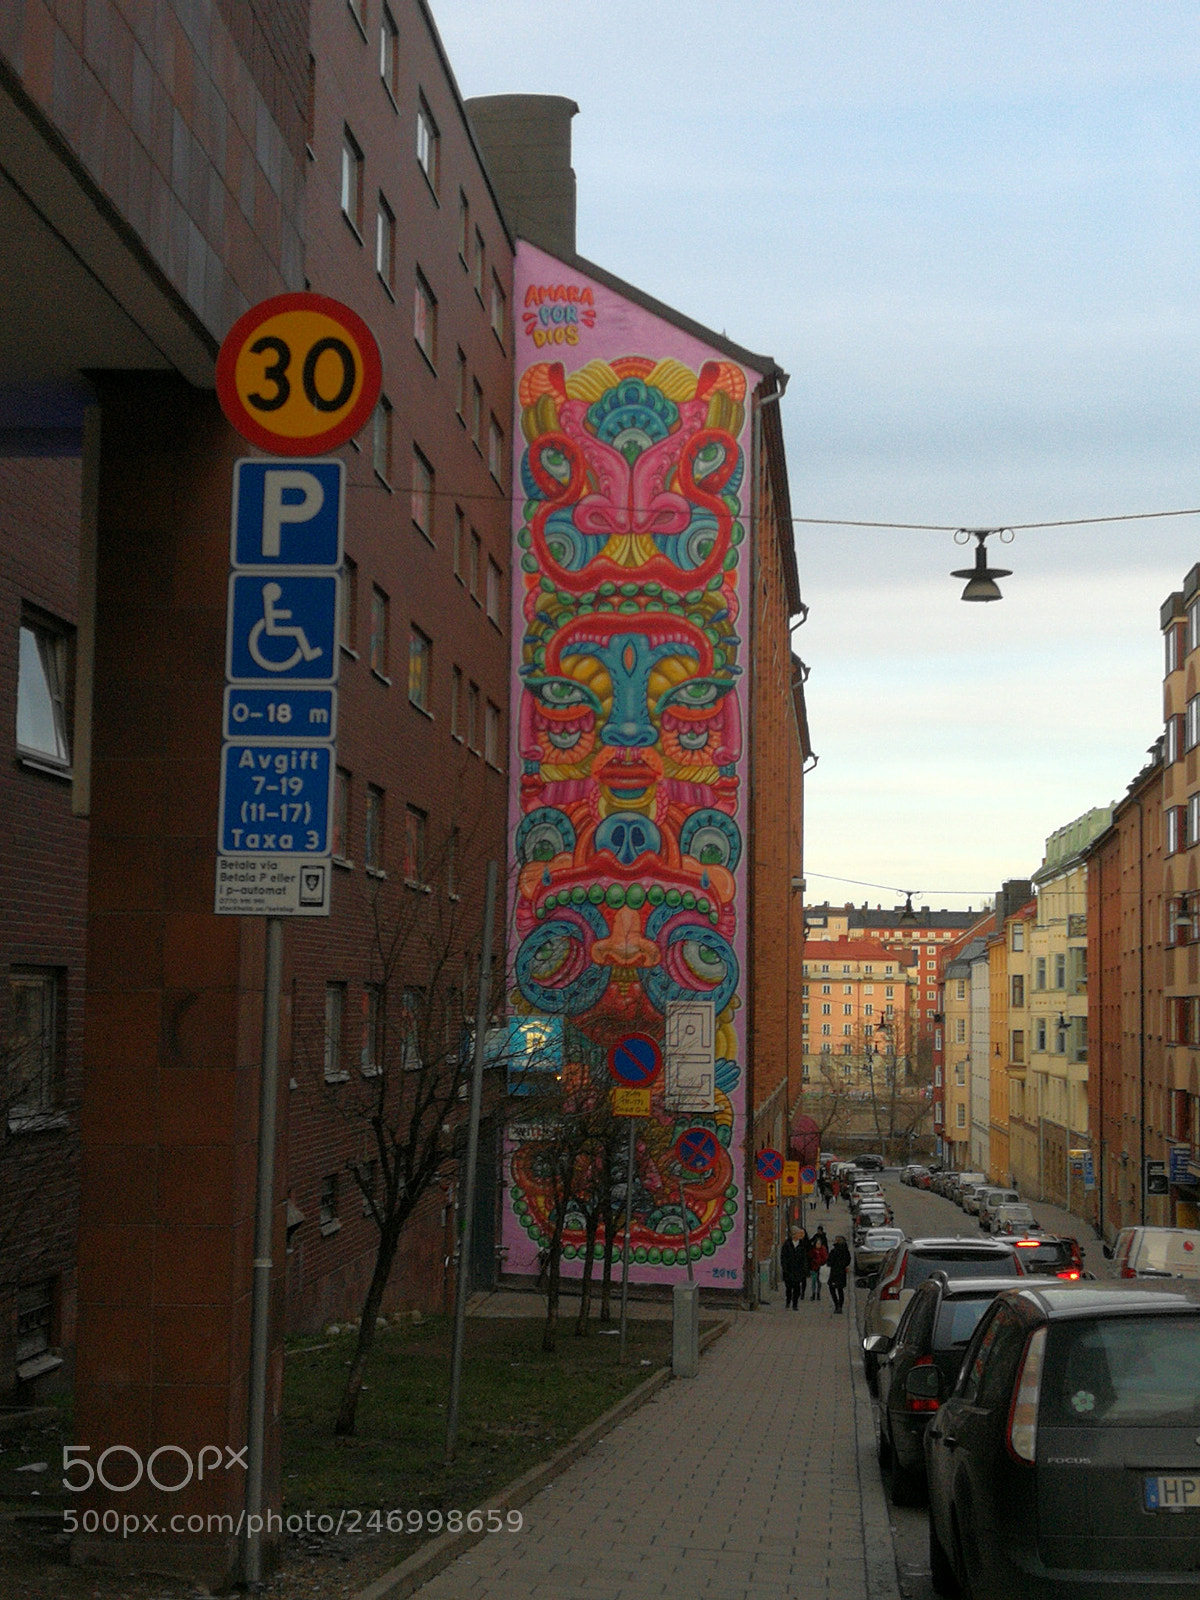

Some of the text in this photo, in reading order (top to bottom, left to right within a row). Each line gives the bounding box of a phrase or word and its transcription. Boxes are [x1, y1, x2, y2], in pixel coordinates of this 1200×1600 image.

[524, 285, 595, 307] AMARA
[539, 305, 579, 326] POR
[533, 325, 579, 348] DIOS
[247, 336, 356, 412] 30
[261, 469, 325, 558] P
[231, 702, 329, 724] 0-18 m
[237, 748, 319, 775] Avgift
[251, 775, 304, 796] 7-19
[240, 801, 312, 825] (11-17)
[230, 828, 320, 850] Taxa 3
[220, 860, 278, 870] Betala via
[220, 872, 296, 882] Betala P eller
[226, 886, 286, 895] p-automat
[525, 1031, 547, 1055] P
[712, 1268, 738, 1280] 2016
[1047, 1457, 1092, 1465] FOCUS
